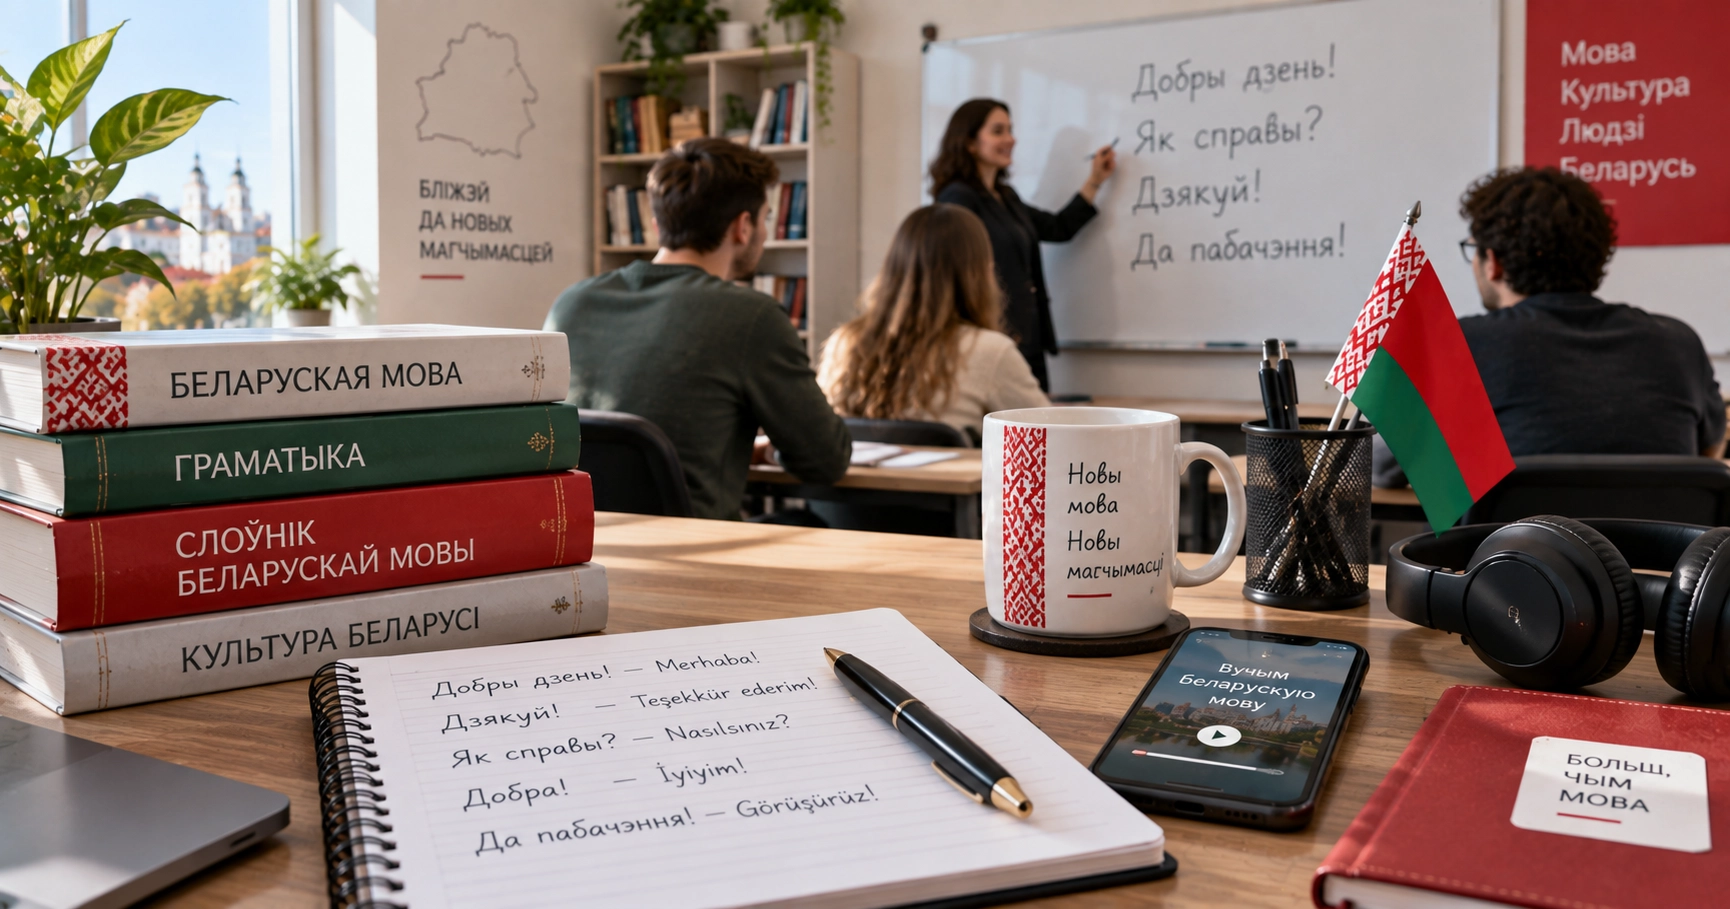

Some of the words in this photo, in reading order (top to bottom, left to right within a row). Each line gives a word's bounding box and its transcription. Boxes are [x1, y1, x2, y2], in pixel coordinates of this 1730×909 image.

[1560, 40, 1636, 67] Мова
[1131, 58, 1225, 103] Добры
[1242, 42, 1335, 92] дзень!
[1560, 75, 1691, 111] Культура
[1134, 119, 1176, 156] Як
[1194, 104, 1323, 160] справы?
[1558, 113, 1645, 146] Людзі
[419, 179, 490, 203] БЛІЖЭЙ
[1131, 168, 1261, 218] Дзякуй!
[418, 210, 446, 233] ДА
[451, 212, 513, 233] НОВЫХ
[419, 240, 553, 265] МАГЧЫМАСЦЕЙ
[1130, 232, 1174, 272] Да
[1190, 221, 1345, 262] пабачэння!
[170, 364, 371, 399] БЕЛАРУСКАЯ
[381, 361, 463, 388] МОВА
[174, 442, 366, 482] ГРАМАТЫКА
[1067, 461, 1121, 484] Новы
[1067, 492, 1119, 514] мова
[175, 518, 316, 559] СЛОЎНІК
[1067, 529, 1120, 551] Новы
[178, 543, 380, 597] БЕЛАРУСКАЙ
[389, 538, 475, 569] МОВЫ
[1066, 552, 1164, 579] магчымасці
[181, 626, 338, 674] КУЛЬТУРА
[348, 606, 480, 649] БЕЛАРУСІ
[431, 677, 519, 700] Добры
[533, 664, 612, 690] дзень!
[655, 651, 760, 673] Merhaba!
[1178, 673, 1317, 701] Беларускую
[1218, 663, 1290, 681] Вучым
[441, 703, 560, 735] Дзякуй!
[630, 688, 730, 709] Teşekkür
[741, 676, 818, 697] ederim!
[1208, 695, 1267, 713] мову
[451, 748, 492, 769] Як
[505, 732, 616, 764] справы?
[664, 713, 790, 741] Nasılsınız?
[1564, 771, 1632, 791] ЧЫМ
[1566, 753, 1672, 778] БОЛЬШ,
[463, 778, 569, 812] Добра!
[655, 757, 748, 788] İyiyim!
[1559, 789, 1650, 813] МОВА
[475, 830, 523, 857] Да
[537, 806, 695, 843] пабачэння!
[736, 783, 879, 818] Görüşürüz!
